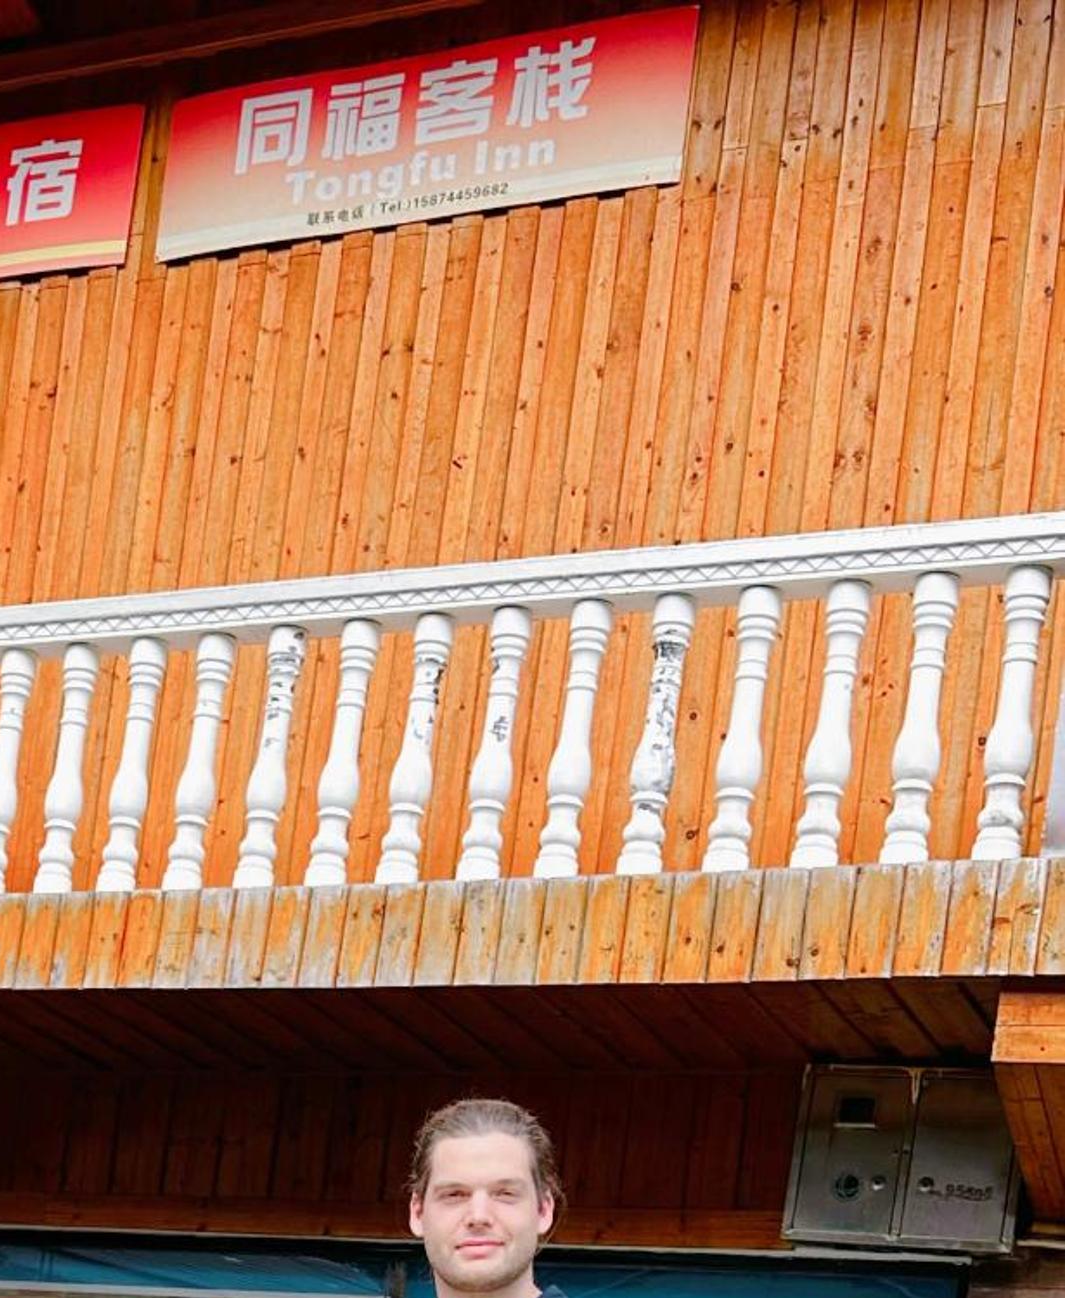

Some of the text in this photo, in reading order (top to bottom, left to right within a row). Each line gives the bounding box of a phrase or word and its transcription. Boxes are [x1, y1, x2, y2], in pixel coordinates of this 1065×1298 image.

[234, 34, 598, 175] 同福客栈
[286, 138, 557, 203] Tongfu Inn
